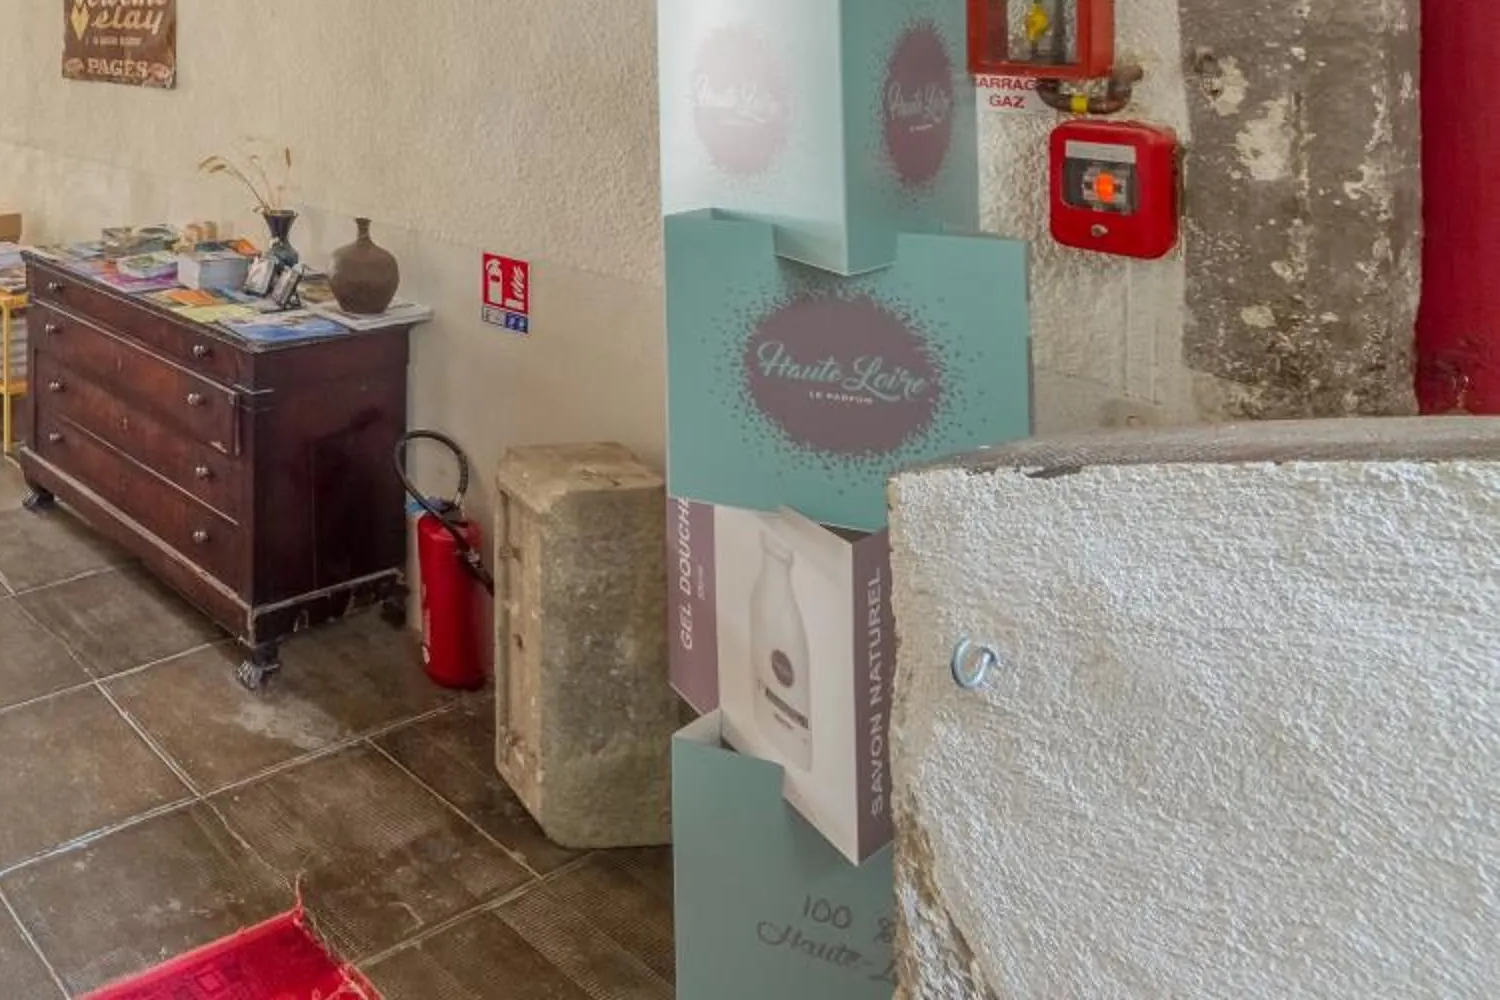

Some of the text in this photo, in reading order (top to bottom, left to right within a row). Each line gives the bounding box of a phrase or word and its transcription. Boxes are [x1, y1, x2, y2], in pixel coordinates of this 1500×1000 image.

[977, 77, 1037, 91] ARRAG
[988, 94, 1026, 109] GAZ
[756, 341, 926, 403] Haute Loire
[679, 599, 693, 650] GEL
[867, 567, 884, 820] SAVON NATUREL
[802, 893, 853, 930] 100
